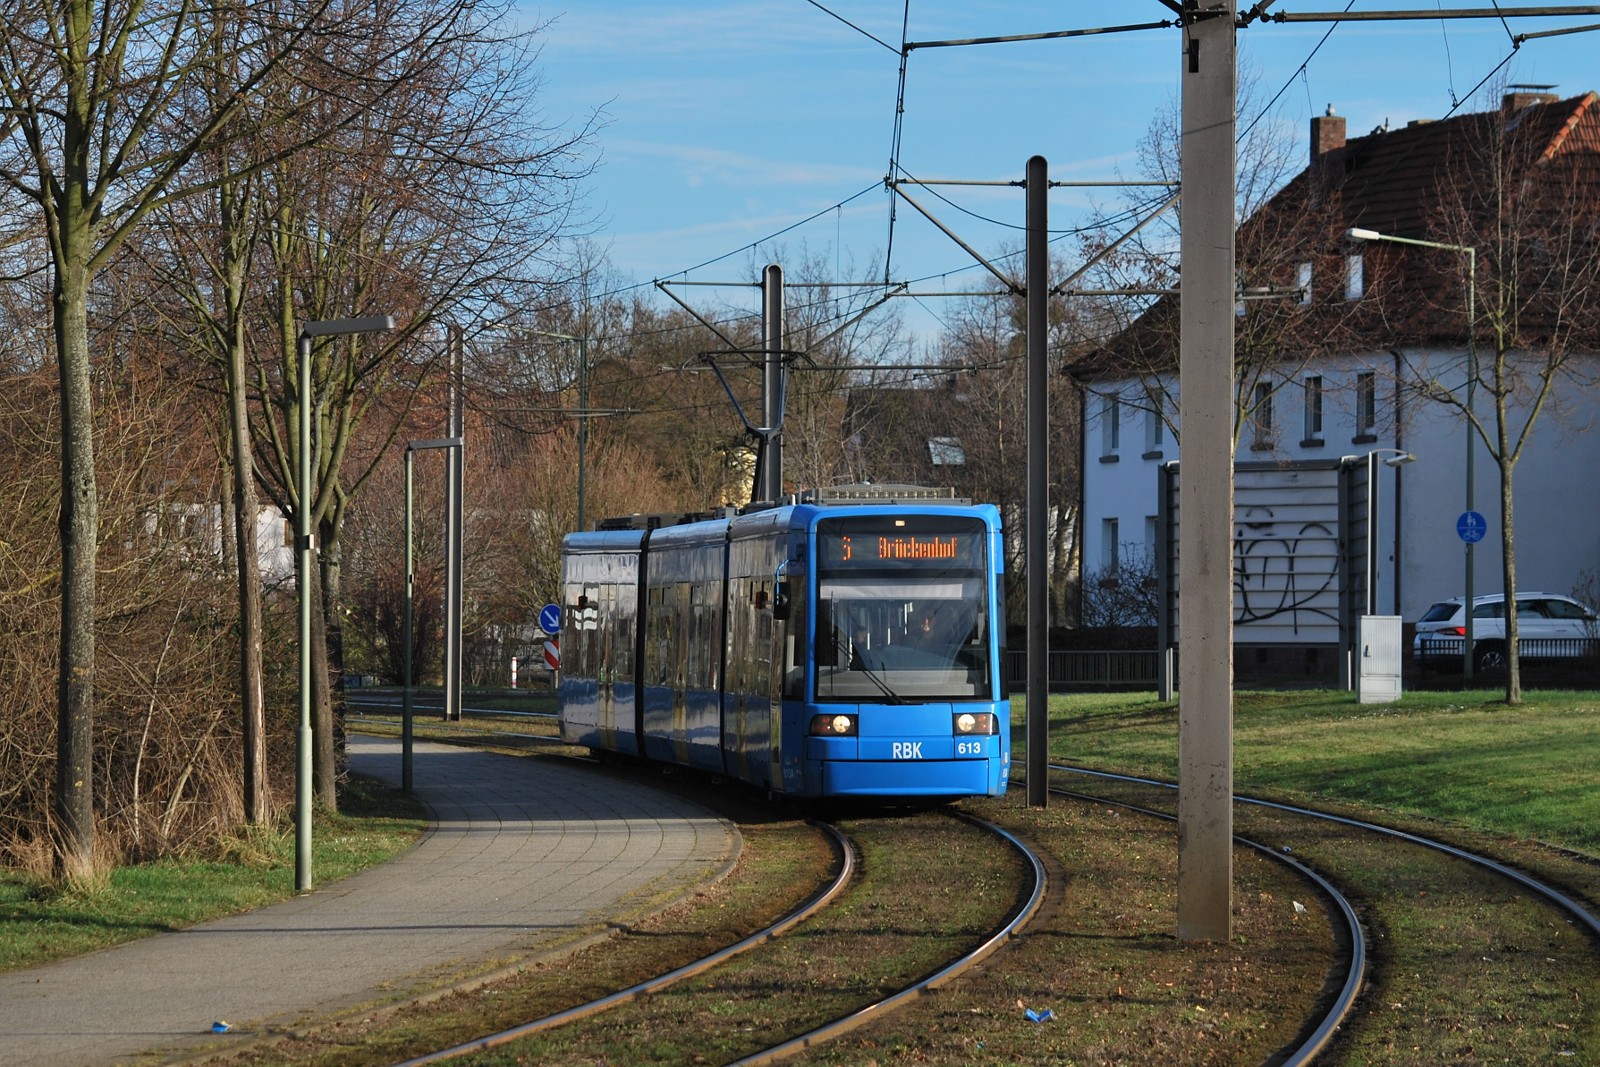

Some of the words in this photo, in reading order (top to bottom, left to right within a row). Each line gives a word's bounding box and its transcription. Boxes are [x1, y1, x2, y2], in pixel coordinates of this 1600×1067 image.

[878, 537, 958, 559] Brückenhof
[892, 742, 923, 760] RBK
[958, 742, 981, 755] 613
